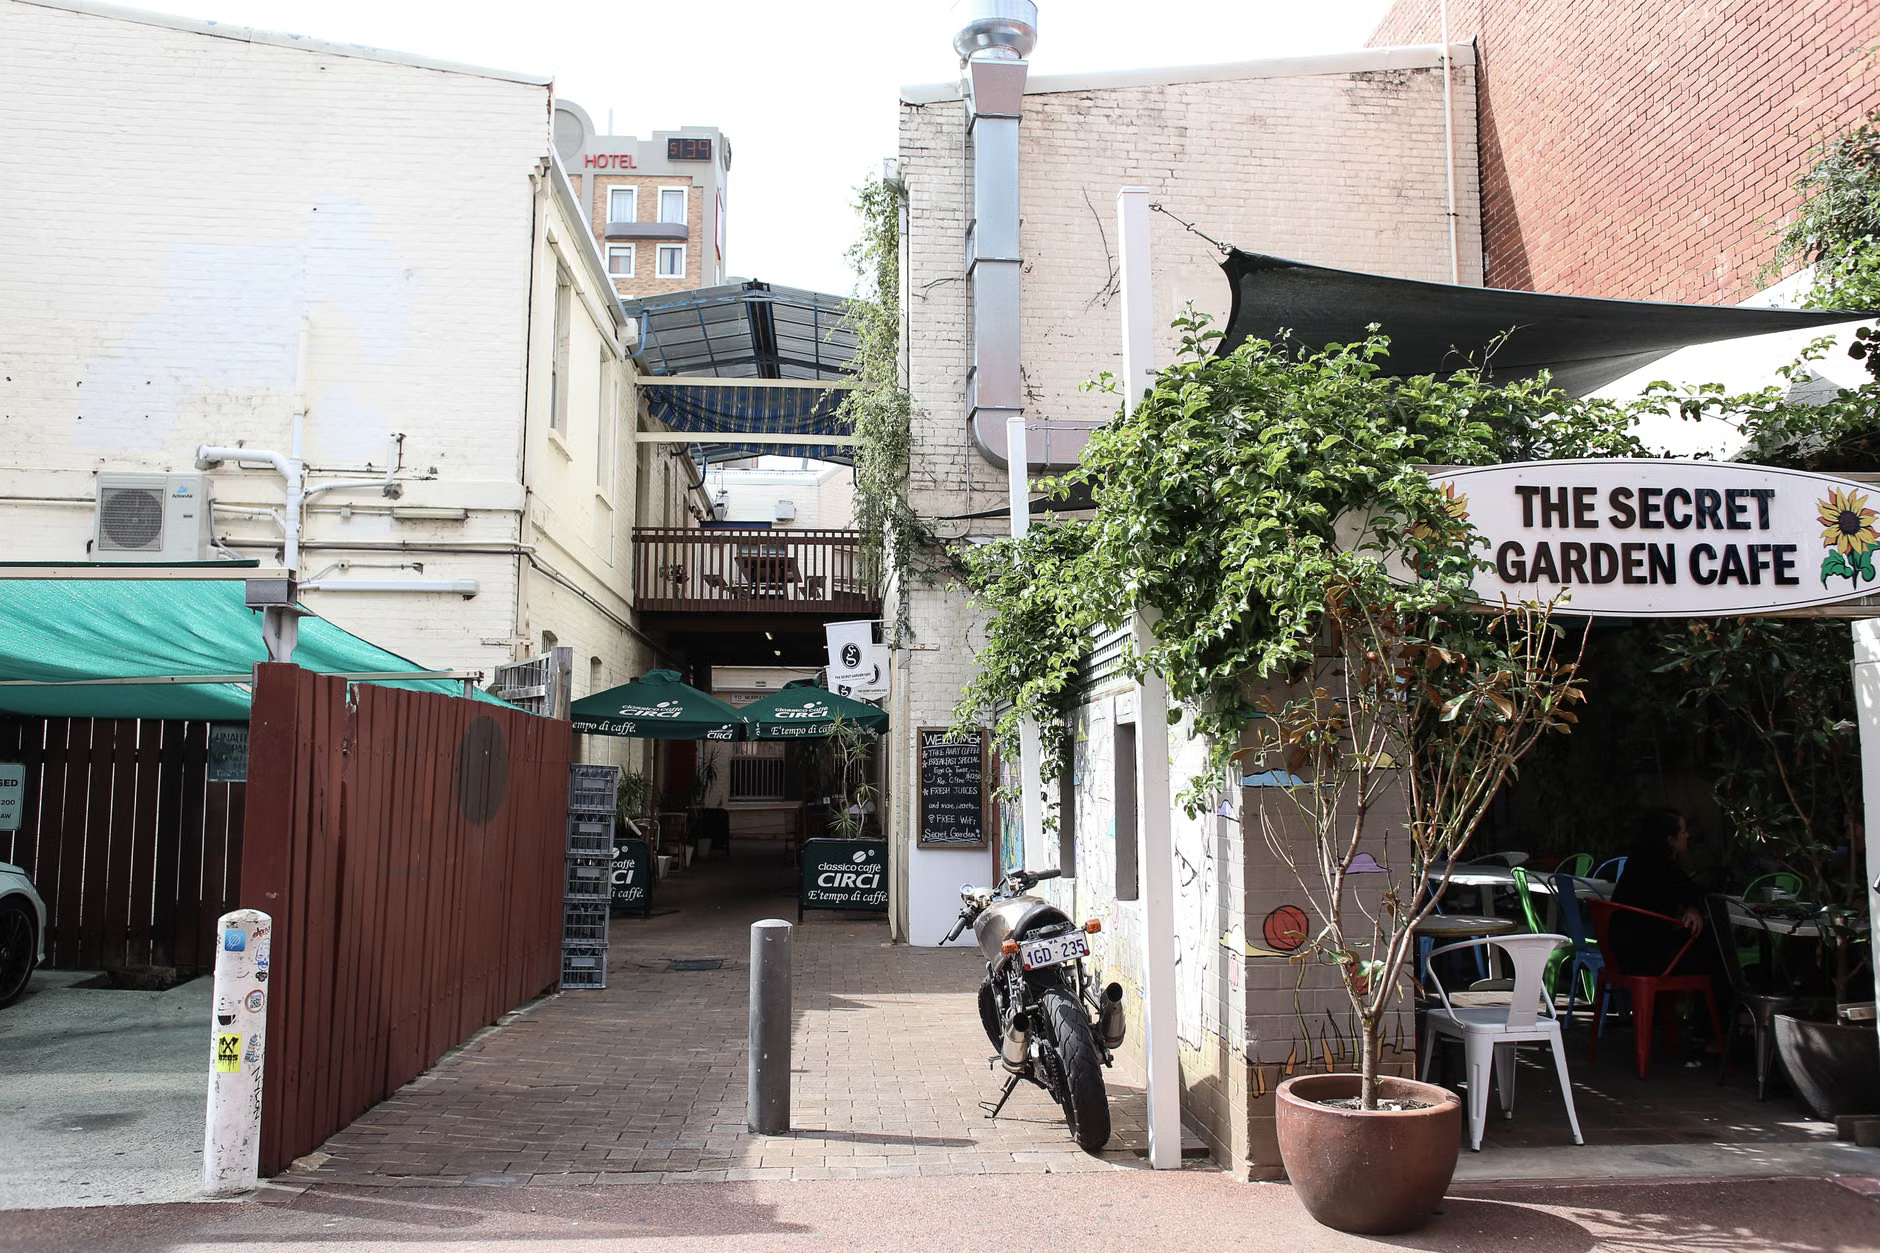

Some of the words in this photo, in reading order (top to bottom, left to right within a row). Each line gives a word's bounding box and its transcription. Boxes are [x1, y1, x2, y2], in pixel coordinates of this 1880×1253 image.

[584, 153, 638, 169] HOTEL
[1515, 485, 1599, 529] THE
[1608, 487, 1775, 531] SECRET
[1496, 540, 1677, 585] GARDEN
[1689, 543, 1800, 586] CAFE
[619, 709, 681, 718] CIRCI
[775, 710, 828, 718] CIRCI
[572, 721, 597, 732] empo
[598, 720, 610, 731] di
[808, 724, 817, 734] di
[706, 732, 733, 740] CIRCI
[928, 748, 944, 756] TAKE
[945, 747, 961, 756] AWAY
[961, 746, 980, 755] COFFEE
[928, 757, 957, 766] BREAKFAST
[958, 756, 980, 765] SPECIAL
[930, 787, 951, 795] FRESH
[952, 786, 978, 795] JUICES
[928, 801, 940, 809] and
[936, 814, 956, 823] FREE
[924, 828, 948, 838] Secret
[949, 827, 976, 838] Garden
[818, 862, 857, 872] classico
[857, 863, 881, 873] caffè
[817, 872, 880, 889] CIRCI
[850, 890, 861, 901] di
